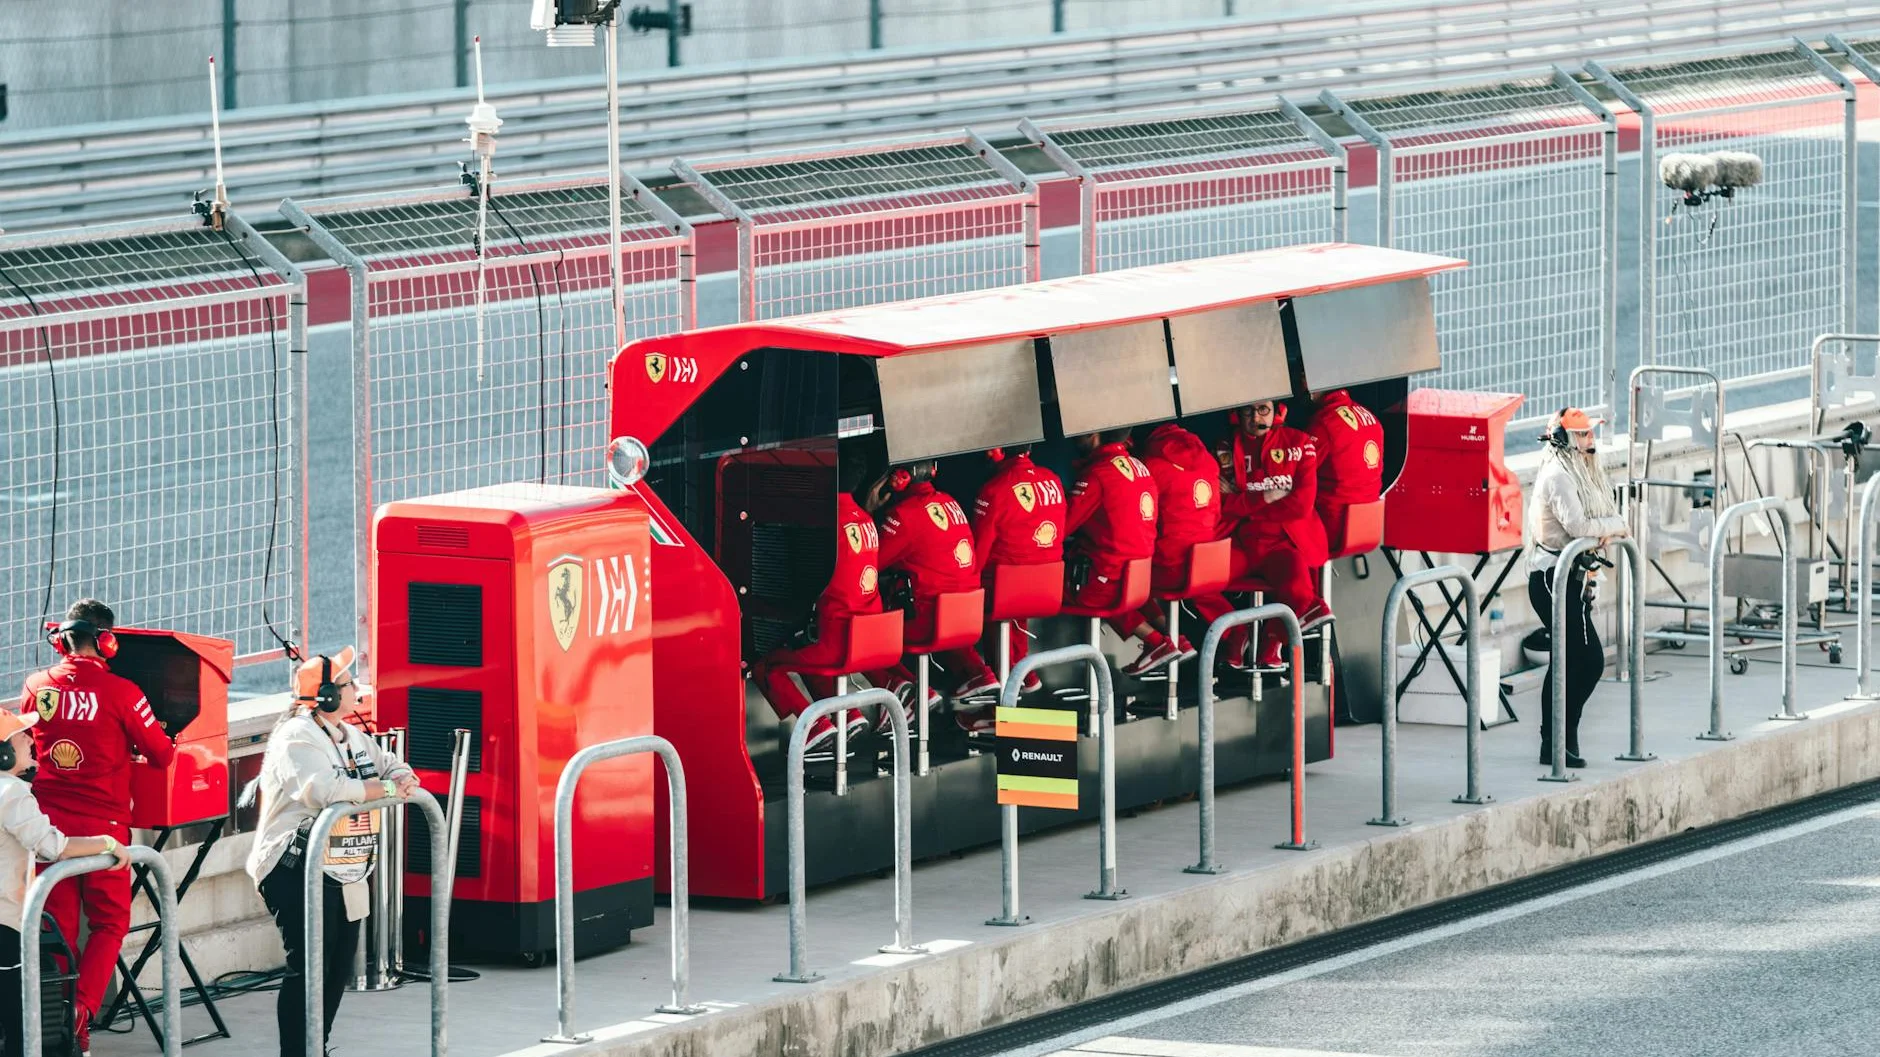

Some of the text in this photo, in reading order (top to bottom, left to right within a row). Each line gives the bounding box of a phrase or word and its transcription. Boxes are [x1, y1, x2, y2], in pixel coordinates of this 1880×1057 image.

[1022, 751, 1063, 762] RENAULT
[342, 834, 377, 846] PIT LANE
